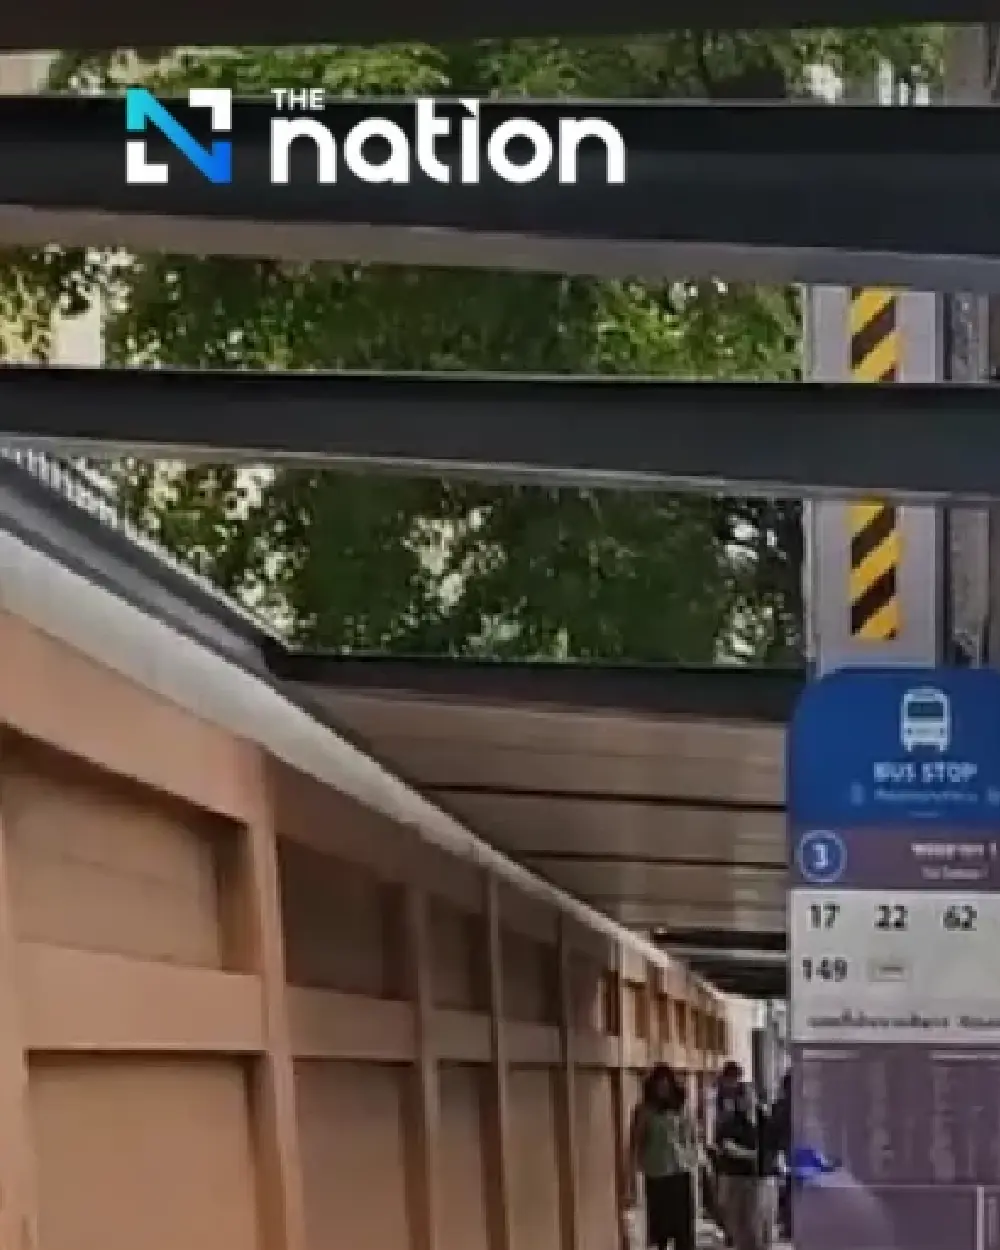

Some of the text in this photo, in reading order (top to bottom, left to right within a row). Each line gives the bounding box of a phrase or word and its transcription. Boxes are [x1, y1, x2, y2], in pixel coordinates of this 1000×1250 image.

[873, 761, 978, 783] BUS STOP
[808, 903, 840, 929] 17
[874, 903, 909, 931] 22
[942, 903, 978, 931] 62
[802, 957, 848, 983] 149
